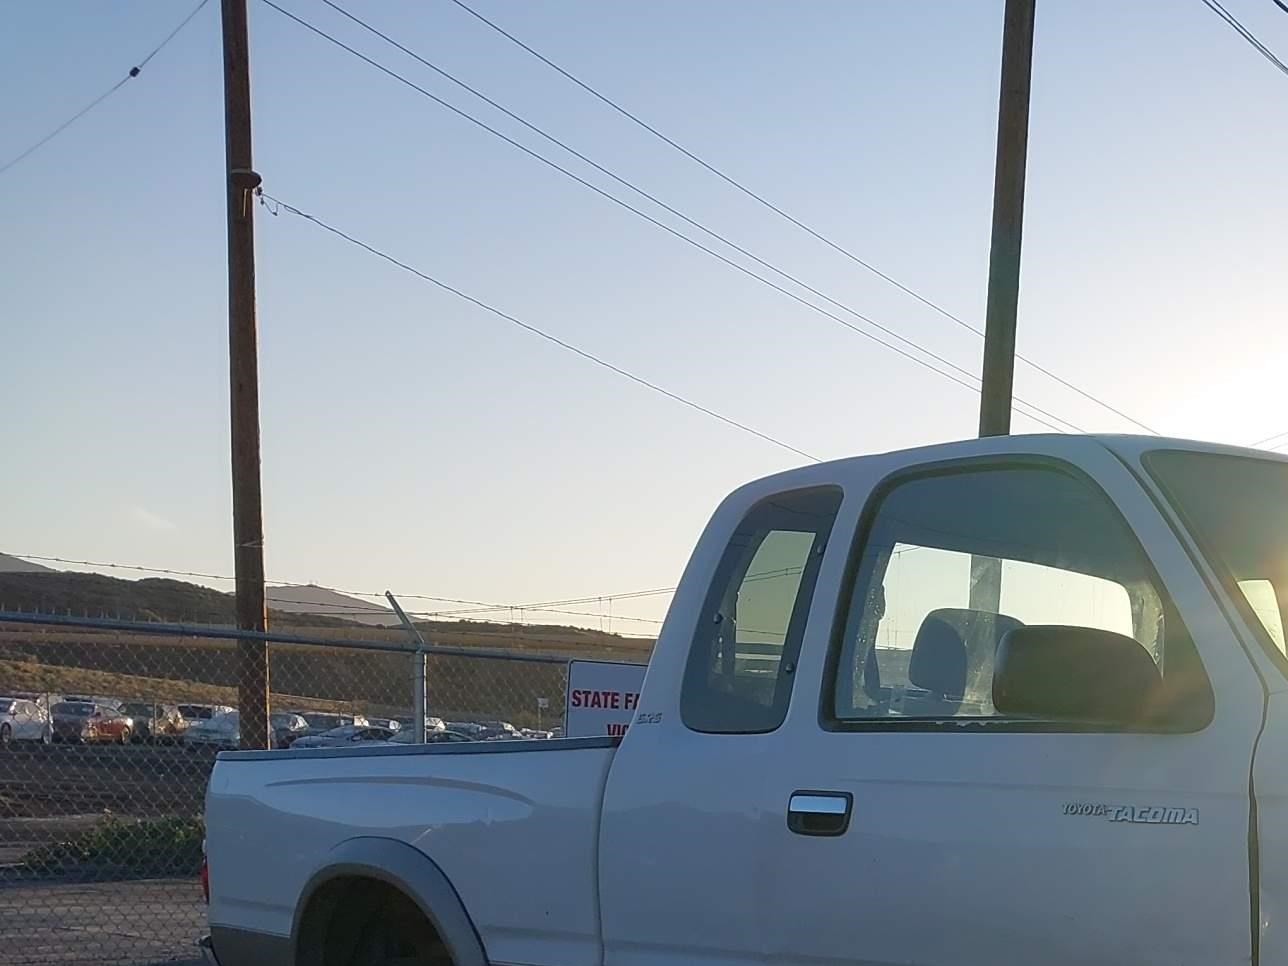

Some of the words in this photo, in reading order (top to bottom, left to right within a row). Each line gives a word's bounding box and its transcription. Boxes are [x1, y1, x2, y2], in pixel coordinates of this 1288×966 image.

[571, 689, 620, 709] STATE
[1063, 803, 1106, 816] TOYOTA
[1106, 805, 1200, 826] TACOMA
